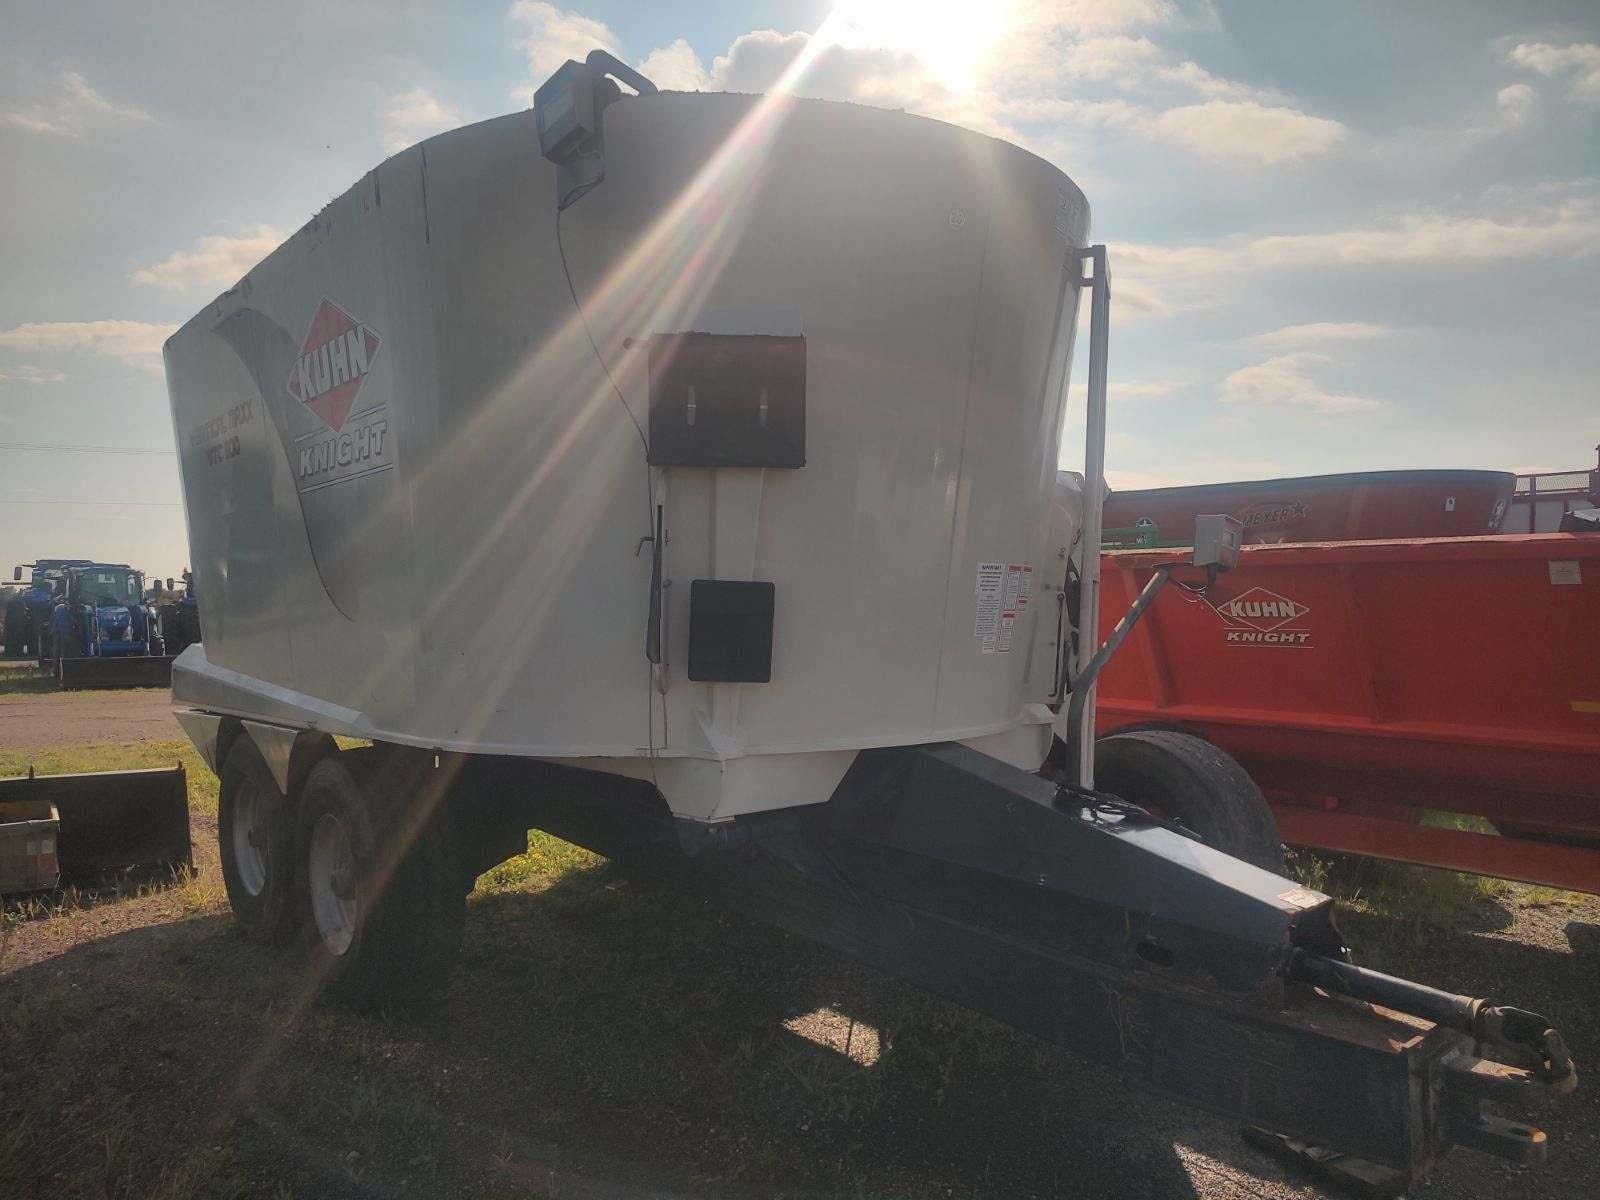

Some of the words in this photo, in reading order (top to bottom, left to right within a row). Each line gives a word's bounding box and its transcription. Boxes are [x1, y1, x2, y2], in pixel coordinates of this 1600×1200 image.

[299, 324, 369, 403] KUHN
[300, 420, 387, 479] KNIGHT
[1230, 601, 1296, 617] KUHN
[1227, 632, 1310, 643] KNIGHT
